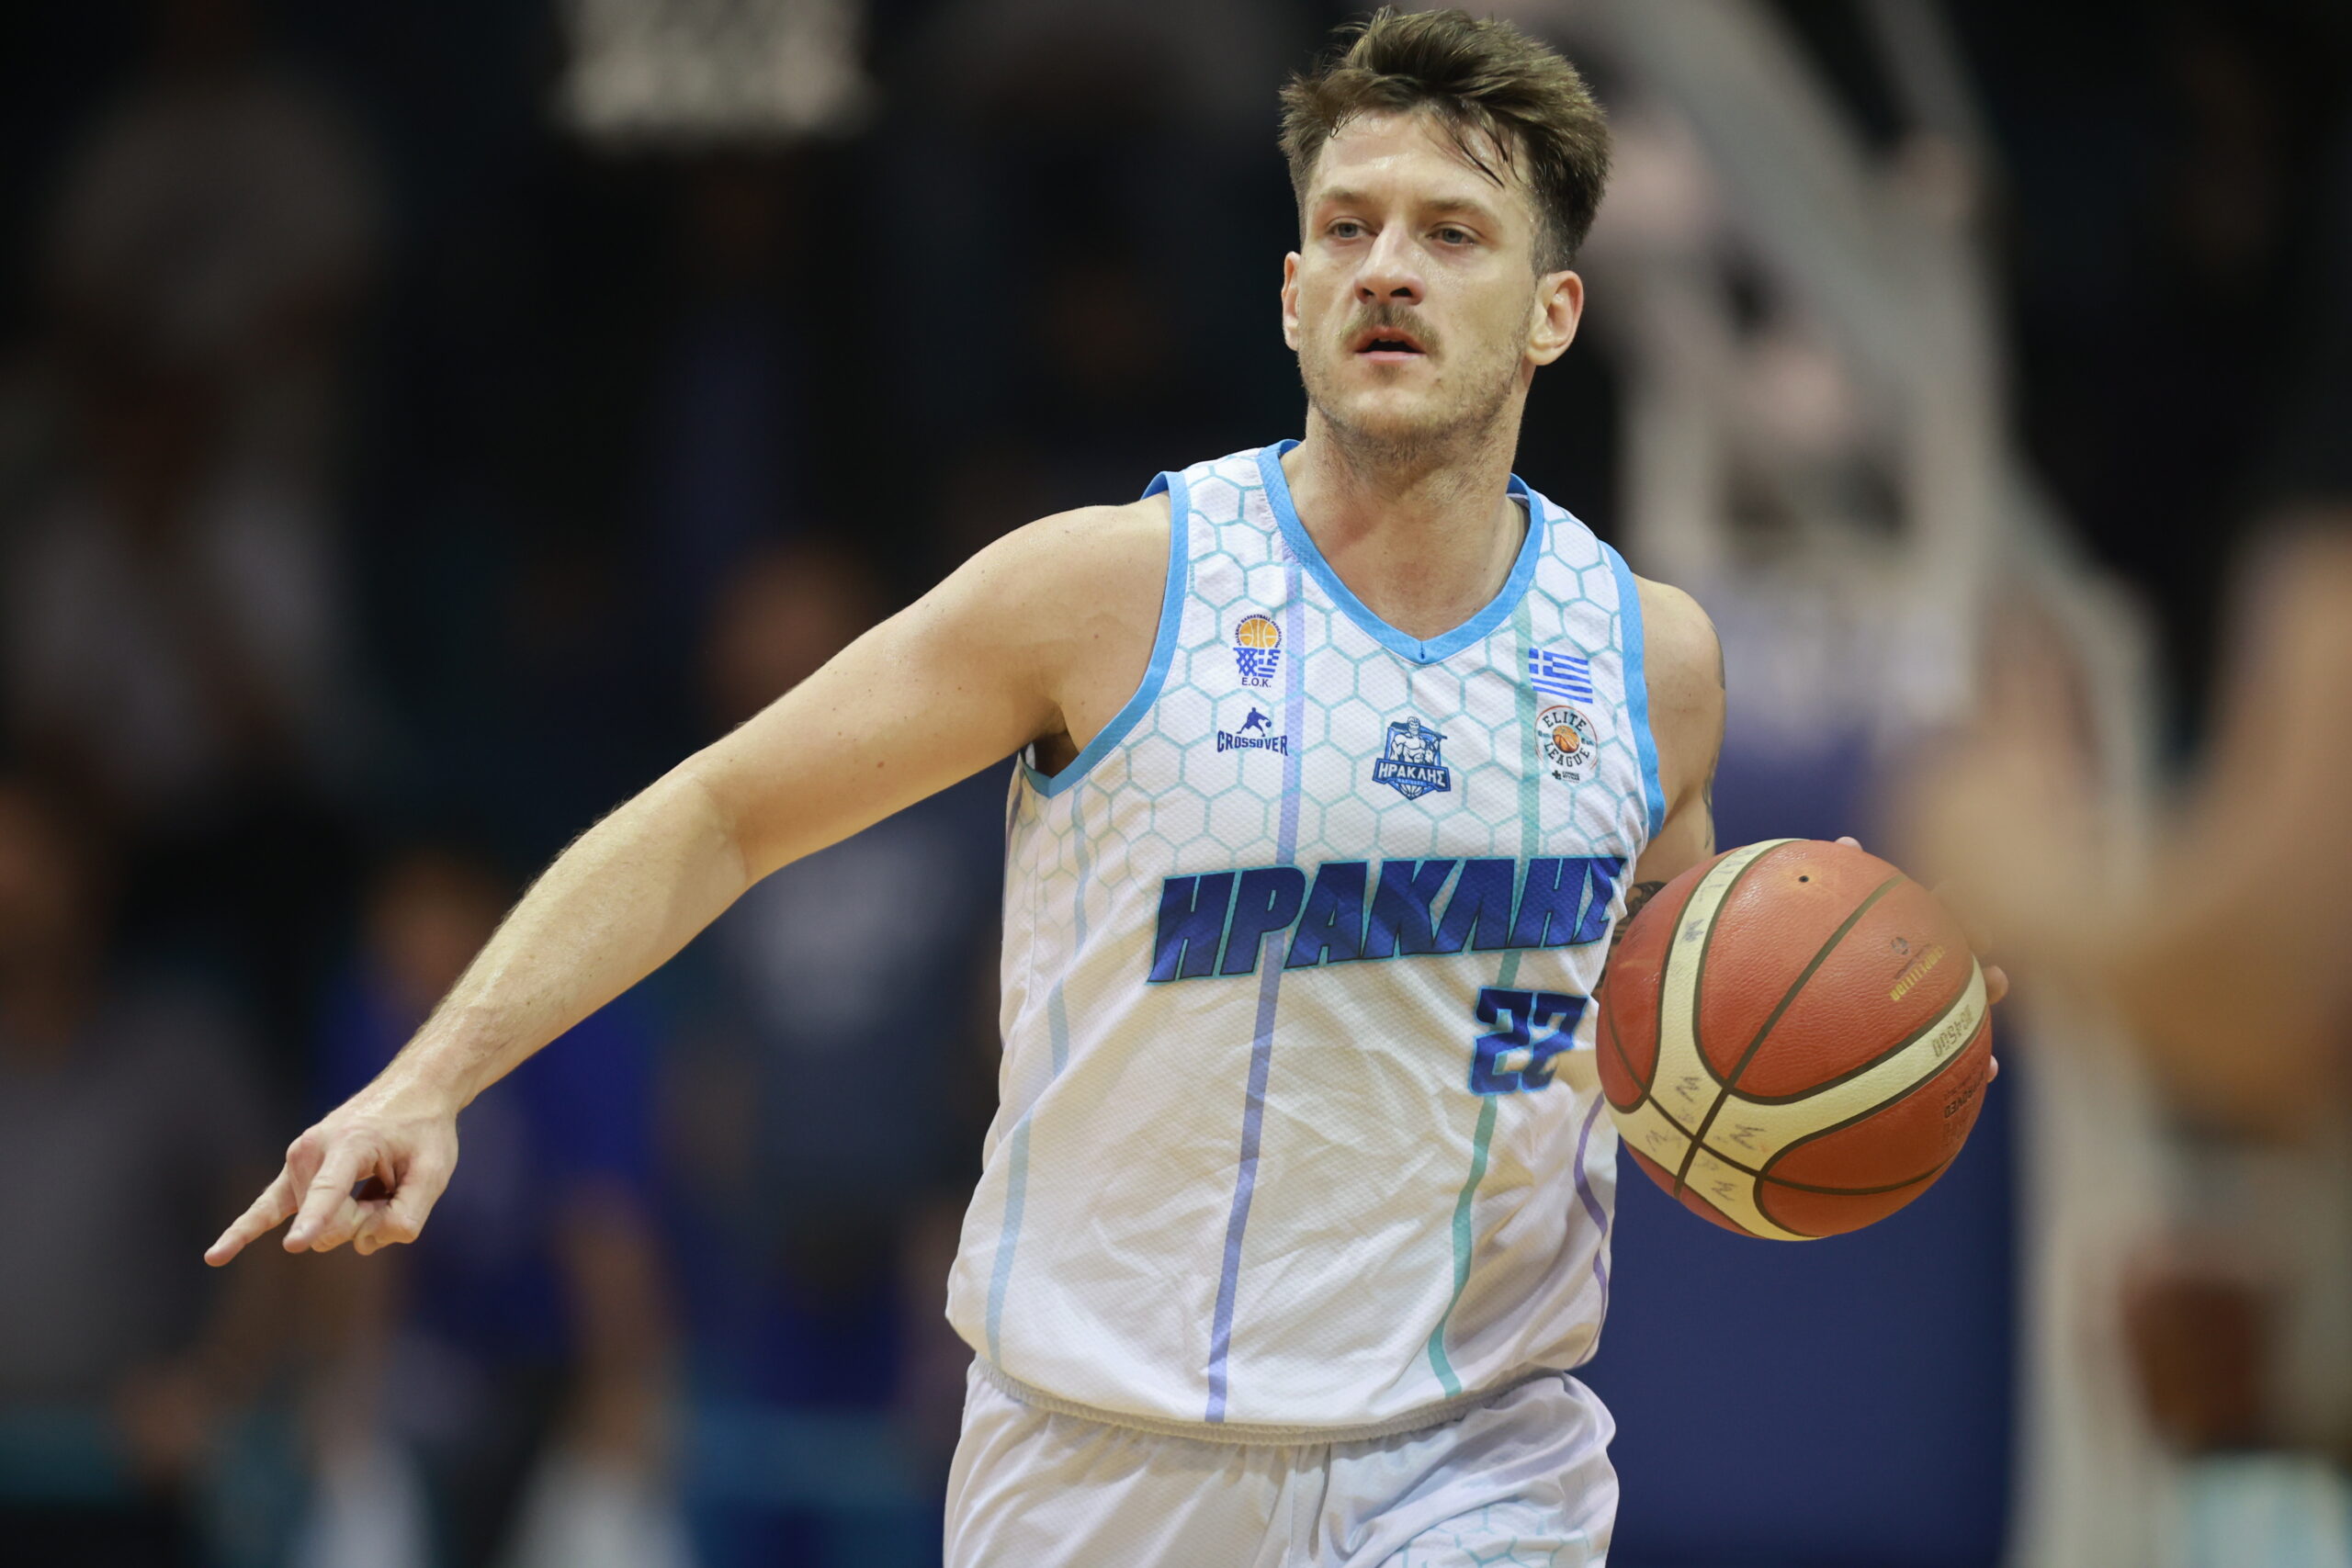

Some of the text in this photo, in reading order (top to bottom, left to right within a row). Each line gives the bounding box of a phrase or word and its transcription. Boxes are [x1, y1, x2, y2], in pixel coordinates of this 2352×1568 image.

[1240, 614, 1272, 624] BASKETBALL
[1542, 711, 1587, 732] ELITE
[1216, 729, 1289, 756] CROSSOVER
[1544, 742, 1590, 768] LEAGUE
[1377, 761, 1446, 787] ΗΡΑΚΛΗΣ
[1146, 856, 1628, 986] ΗΡΑΚΛΗΣ
[1467, 985, 1590, 1098] 22
